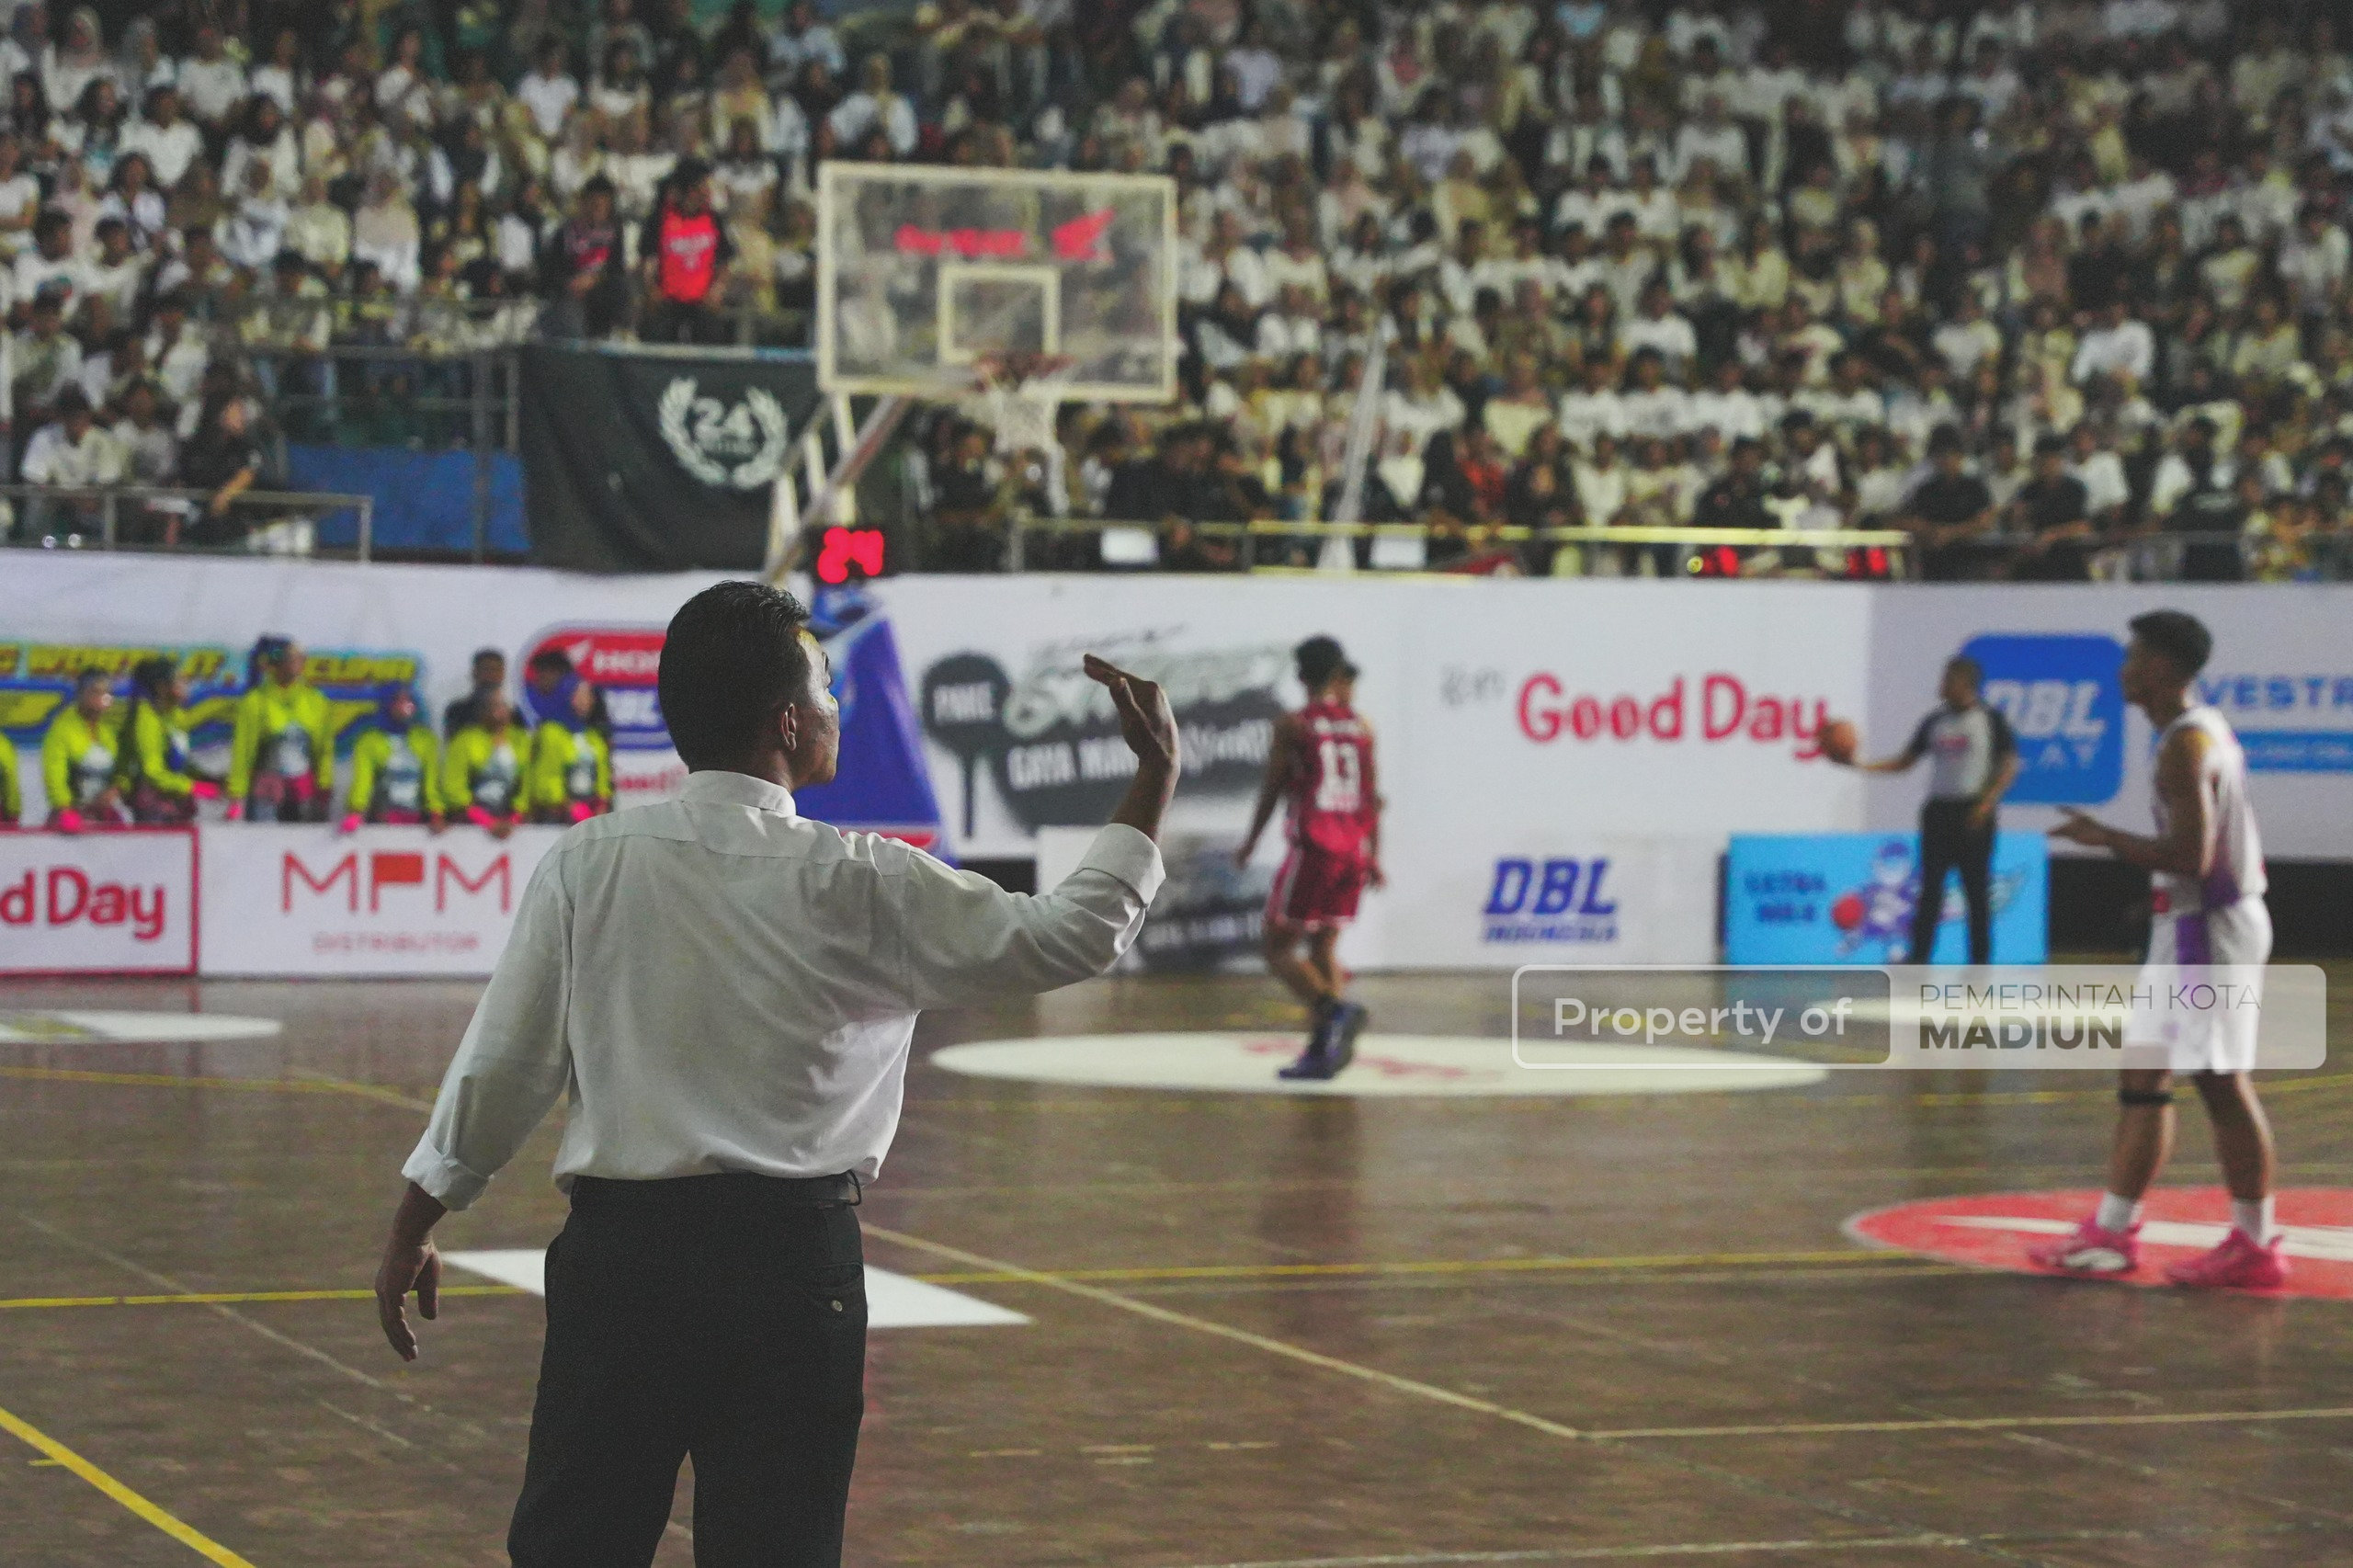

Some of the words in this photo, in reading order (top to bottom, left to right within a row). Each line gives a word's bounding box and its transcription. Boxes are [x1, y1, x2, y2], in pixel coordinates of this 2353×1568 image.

[1517, 672, 1683, 743] Good
[1700, 673, 1827, 761] Day
[46, 866, 165, 941] Day
[282, 850, 511, 914] MPM
[1483, 858, 1619, 916] DBL
